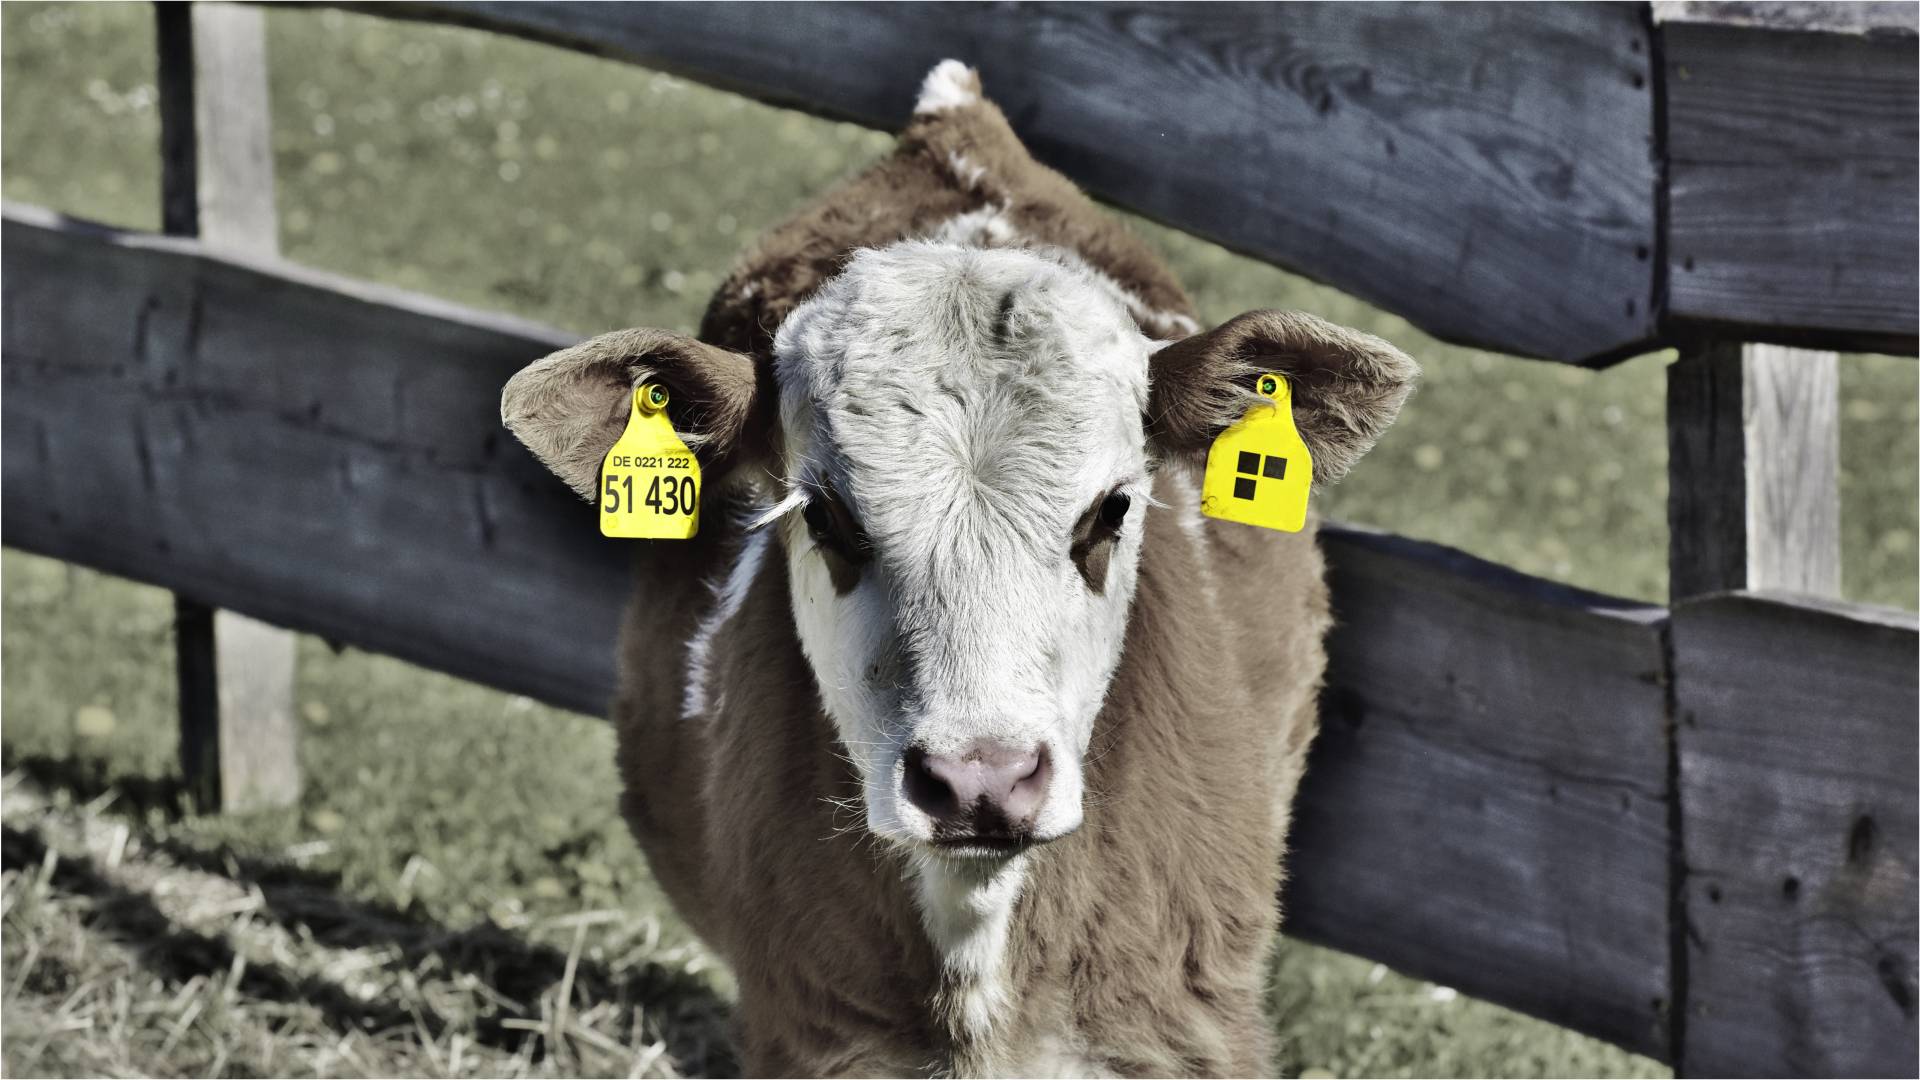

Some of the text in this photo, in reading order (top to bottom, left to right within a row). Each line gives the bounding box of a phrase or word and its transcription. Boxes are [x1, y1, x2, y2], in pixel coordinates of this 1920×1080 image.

[613, 456, 690, 469] DE 0221 222
[605, 475, 696, 516] 51 430
